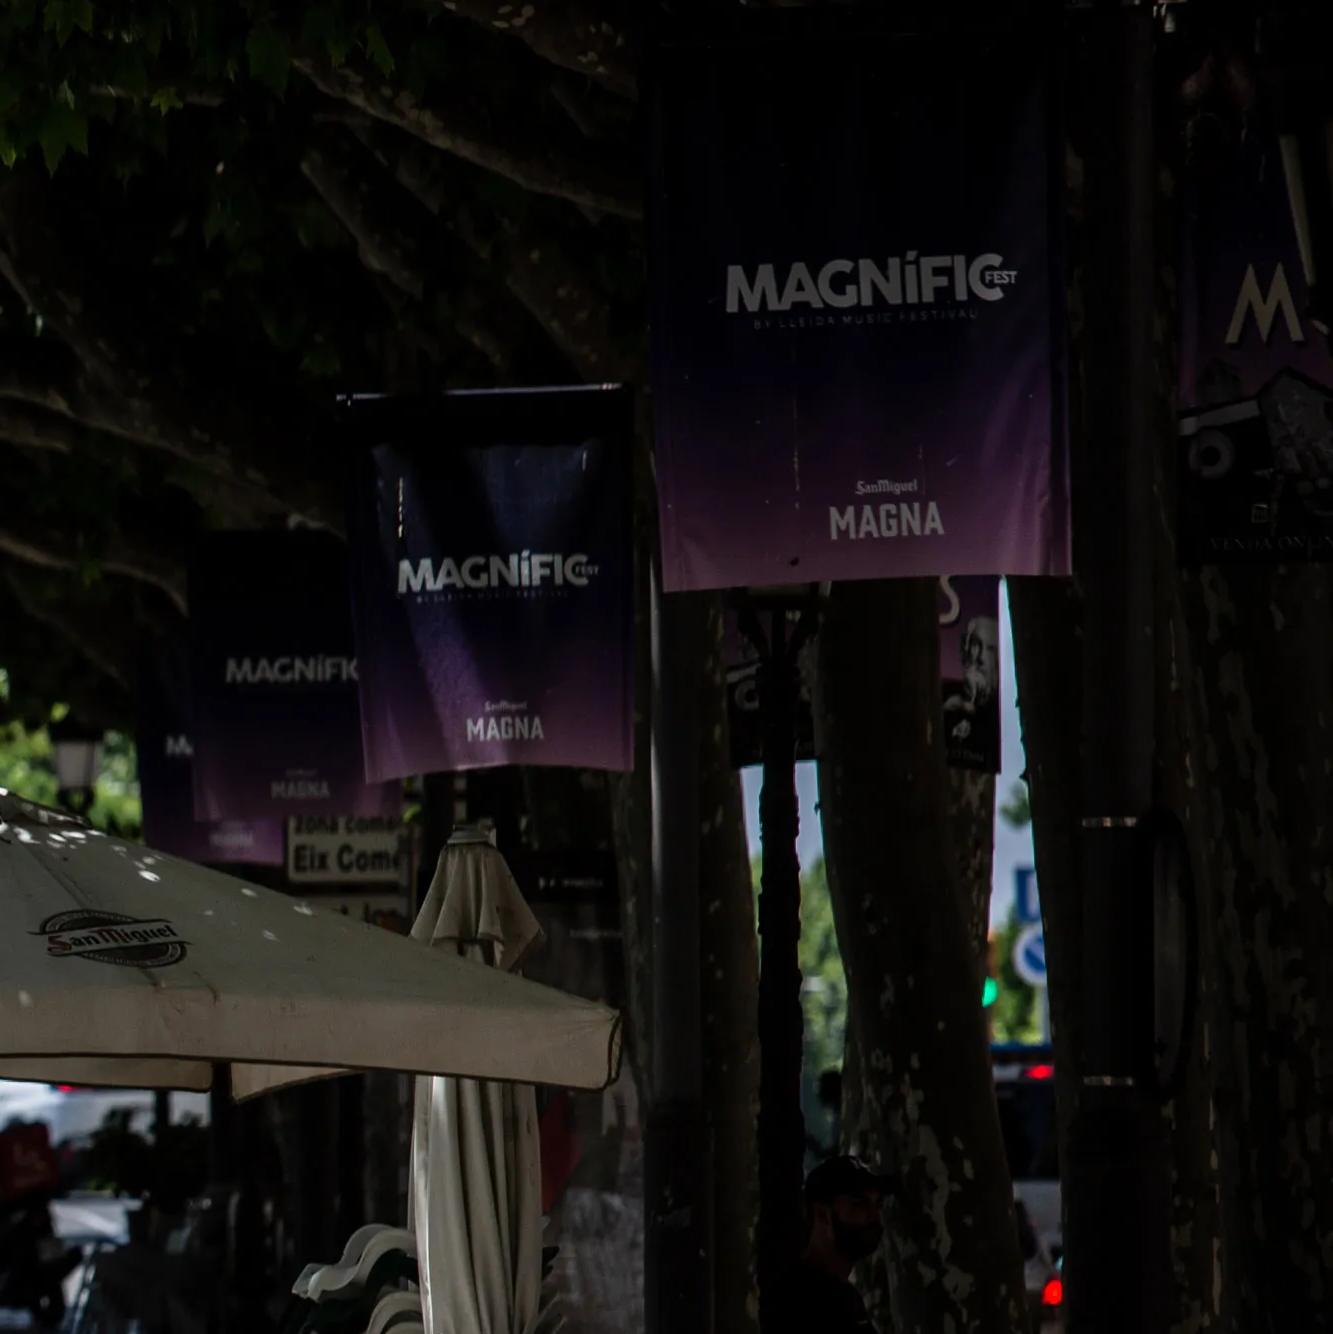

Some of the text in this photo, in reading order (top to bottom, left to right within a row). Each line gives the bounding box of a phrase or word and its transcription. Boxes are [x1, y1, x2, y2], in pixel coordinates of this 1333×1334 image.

[984, 270, 1019, 285] FEST
[841, 312, 893, 326] MUSIC
[829, 501, 945, 540] MAGNA
[466, 715, 545, 742] MAGNA
[295, 845, 328, 873] Eix
